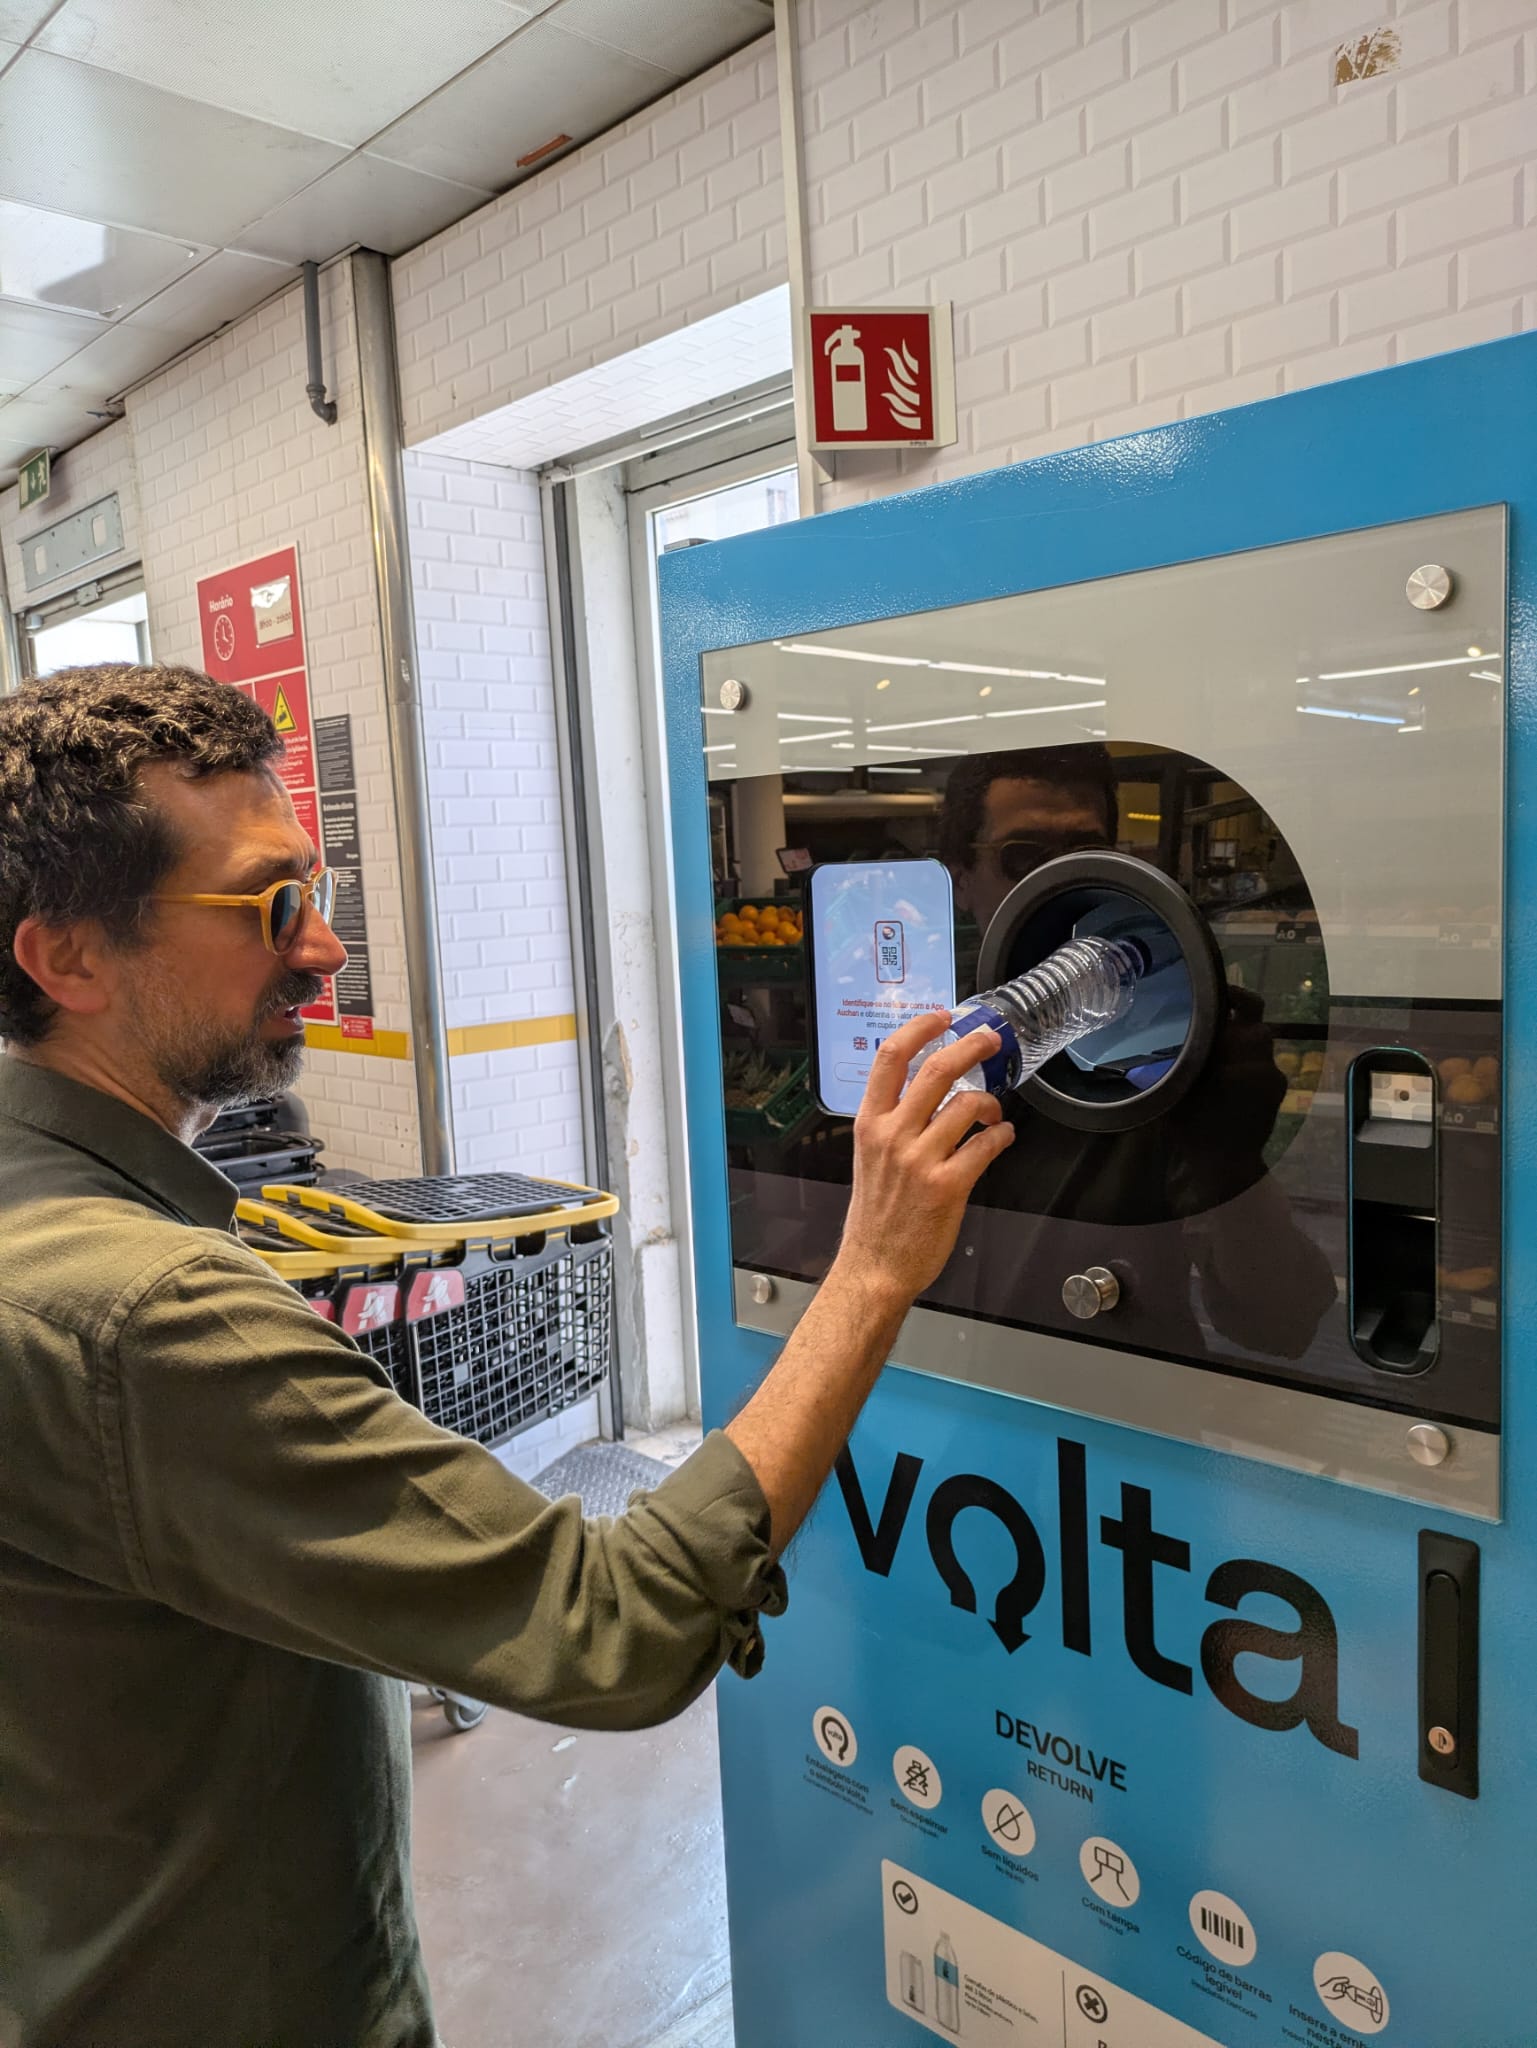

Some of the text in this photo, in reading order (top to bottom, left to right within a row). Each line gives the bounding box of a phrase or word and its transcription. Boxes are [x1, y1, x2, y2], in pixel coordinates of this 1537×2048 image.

[836, 1437, 1359, 1760] volta
[996, 1709, 1127, 1792] DEVOLVE
[1027, 1760, 1094, 1803] RETURN
[981, 1845, 1001, 1863] Sem
[1081, 1896, 1140, 1933] Com tampa
[1176, 1945, 1273, 2003] Código de barras
[1288, 2003, 1328, 2032] Insere
